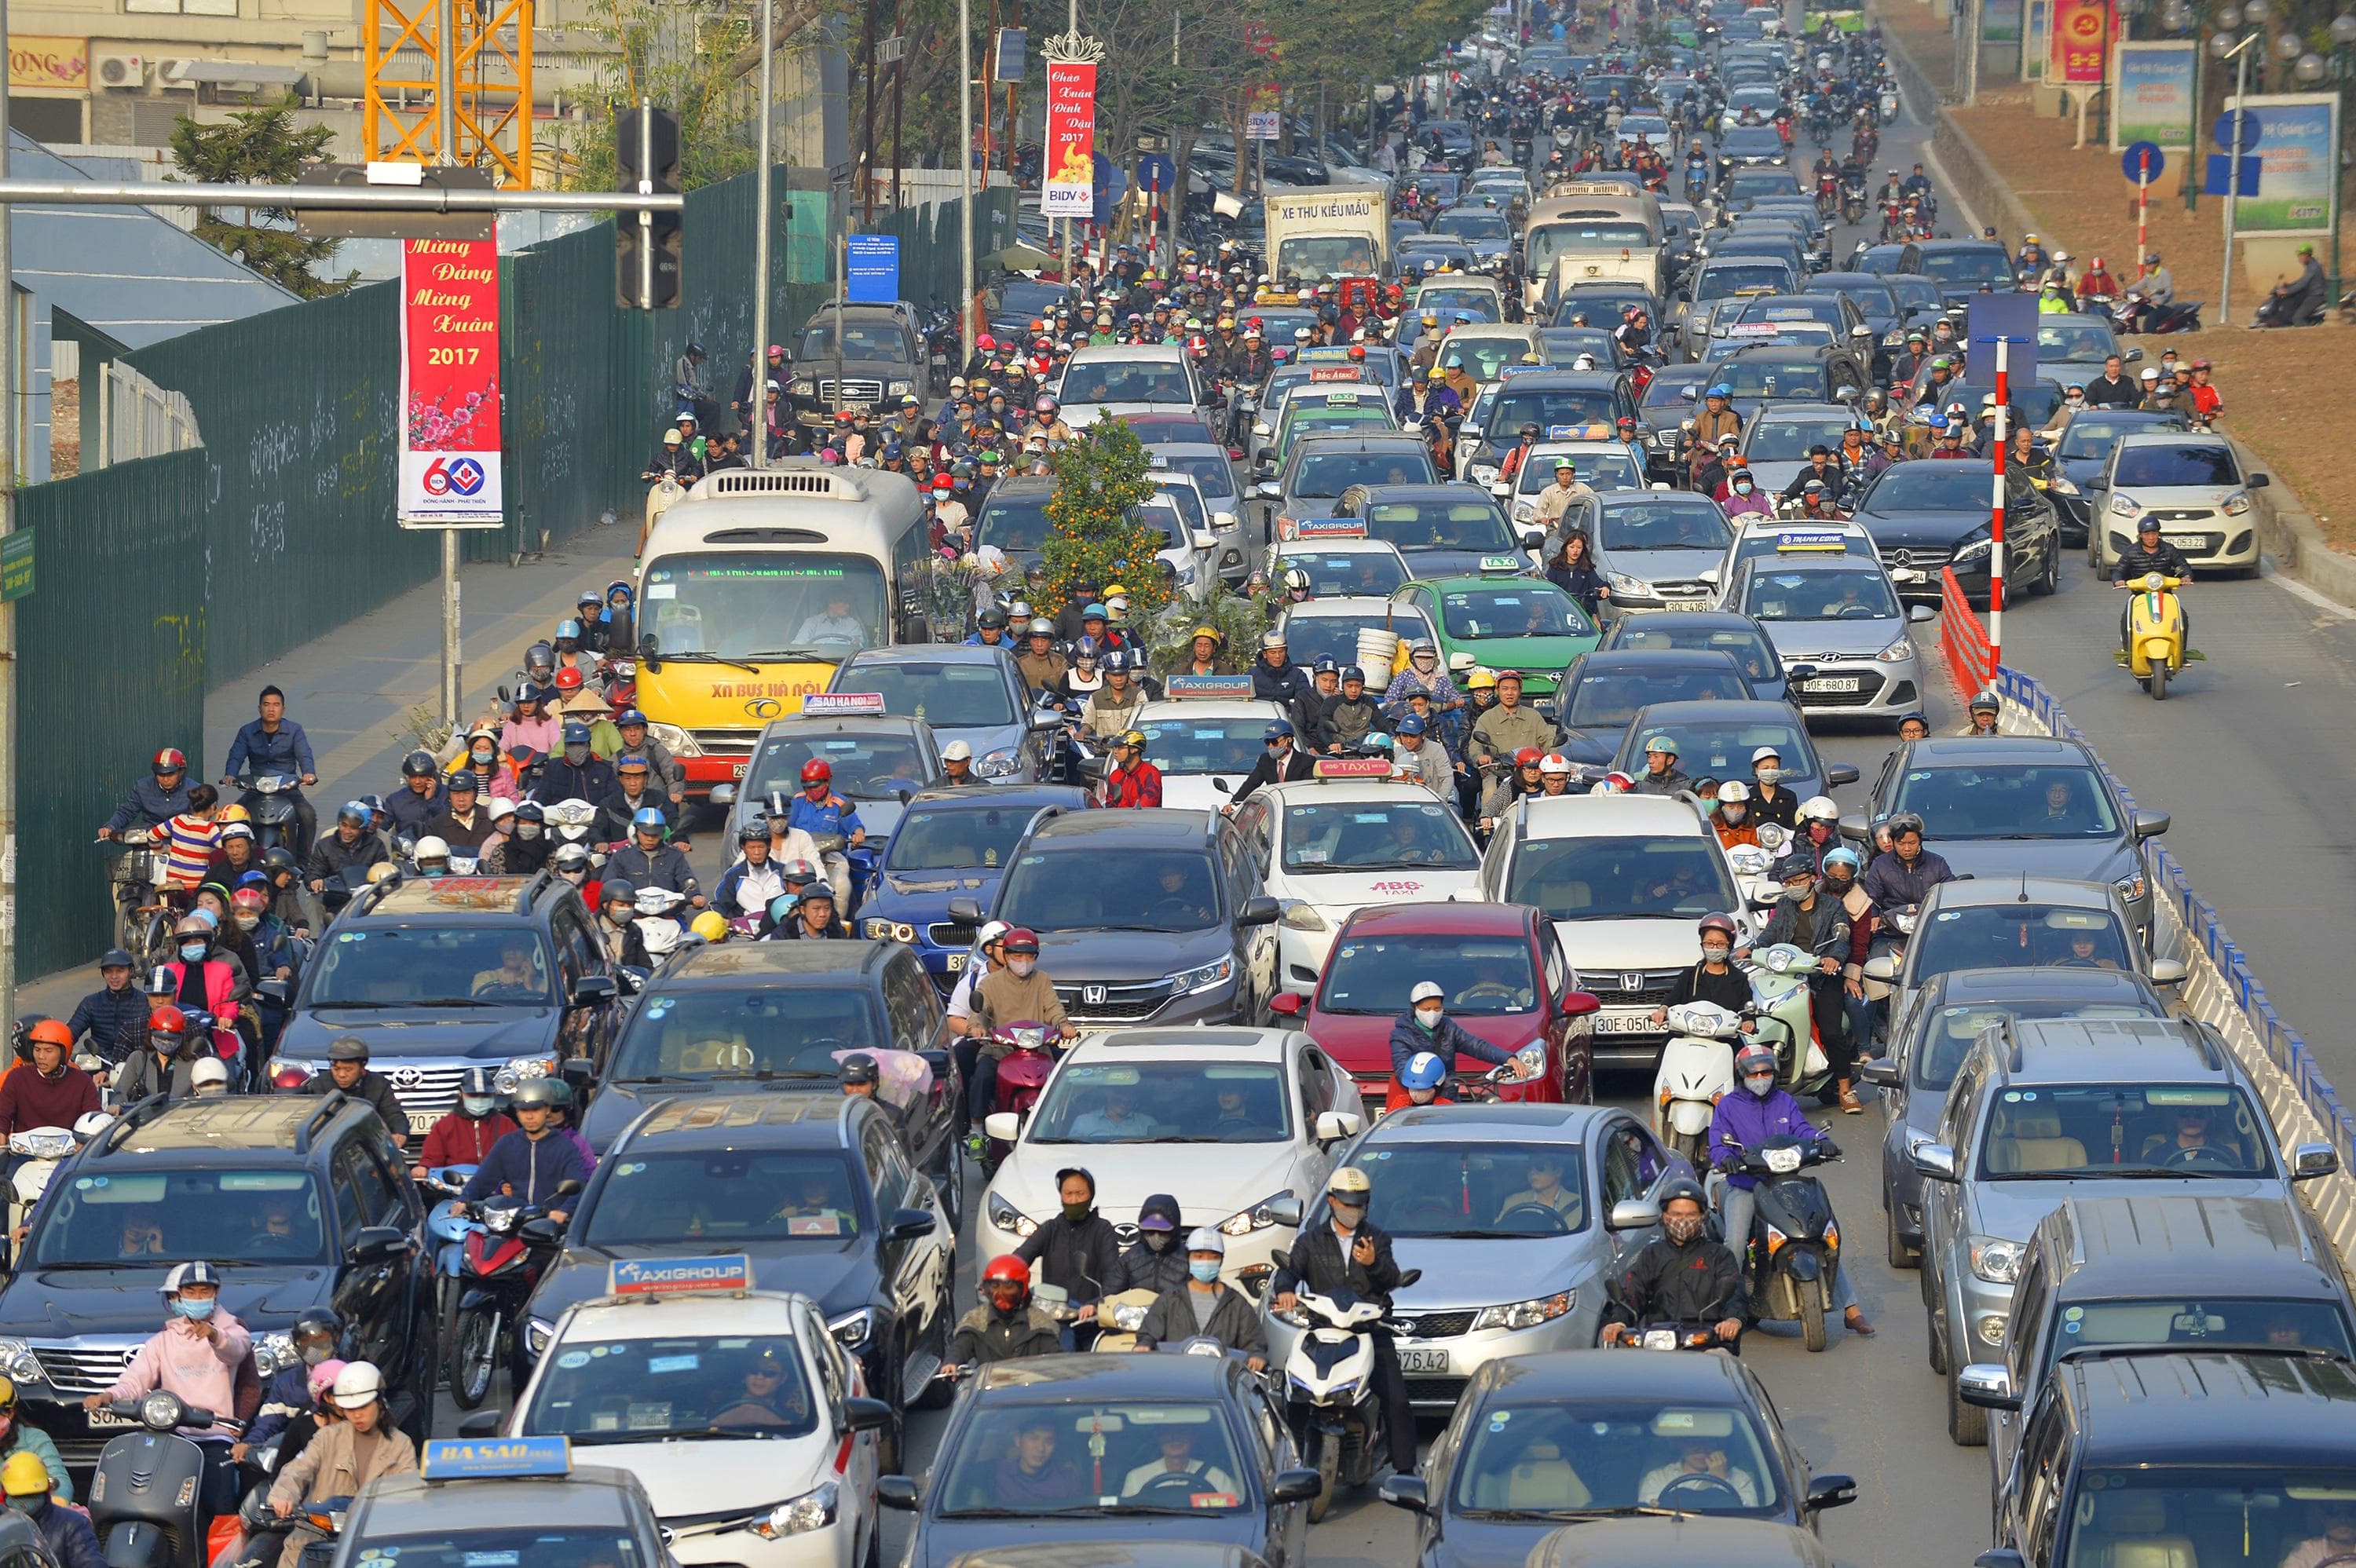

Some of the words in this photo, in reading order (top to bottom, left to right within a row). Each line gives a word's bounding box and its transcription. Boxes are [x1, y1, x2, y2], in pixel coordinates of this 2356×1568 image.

[9, 49, 60, 76] ỢNG
[1060, 133, 1084, 142] 2017
[1049, 190, 1077, 201] BIDV
[1282, 207, 1294, 220] XE
[1297, 204, 1319, 218] THƯ
[408, 239, 470, 258] Mừng
[433, 263, 494, 284] Đảng
[409, 288, 472, 310] Mừng
[434, 314, 495, 333] Xuân
[428, 348, 479, 365] 2017
[737, 684, 763, 696] BUS
[768, 681, 788, 696] HÀ
[1805, 679, 1857, 691] 30E-680.87
[1370, 881, 1424, 890] ABC
[632, 1267, 743, 1281] TAXIGROUP
